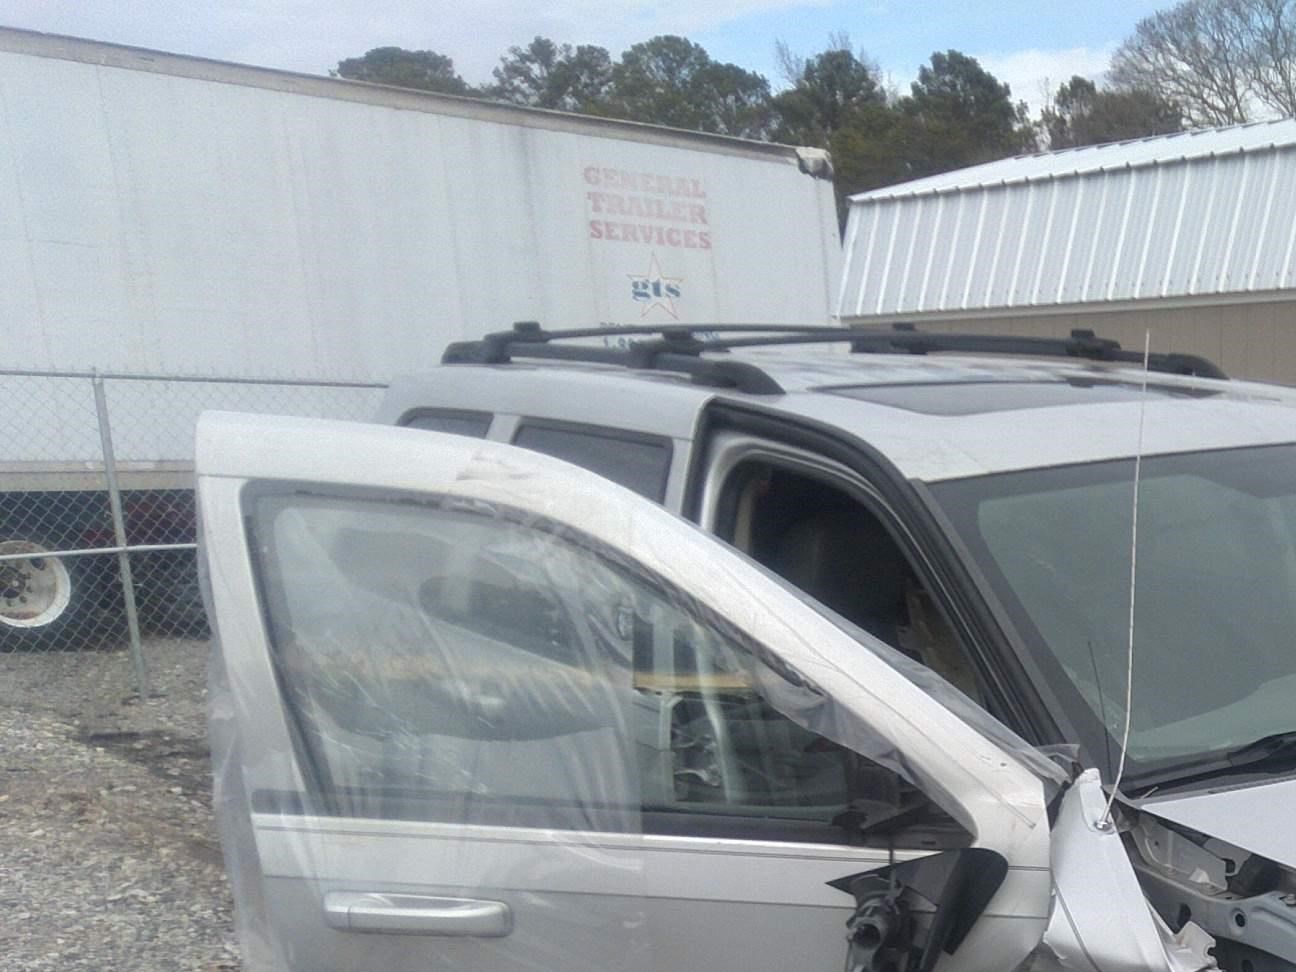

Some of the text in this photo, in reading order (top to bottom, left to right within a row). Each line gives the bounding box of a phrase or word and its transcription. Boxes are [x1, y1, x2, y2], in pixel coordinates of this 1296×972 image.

[583, 166, 706, 199] GENERAL
[586, 191, 708, 225] TRAILER
[589, 220, 712, 249] SERVICES
[631, 279, 681, 302] gts
